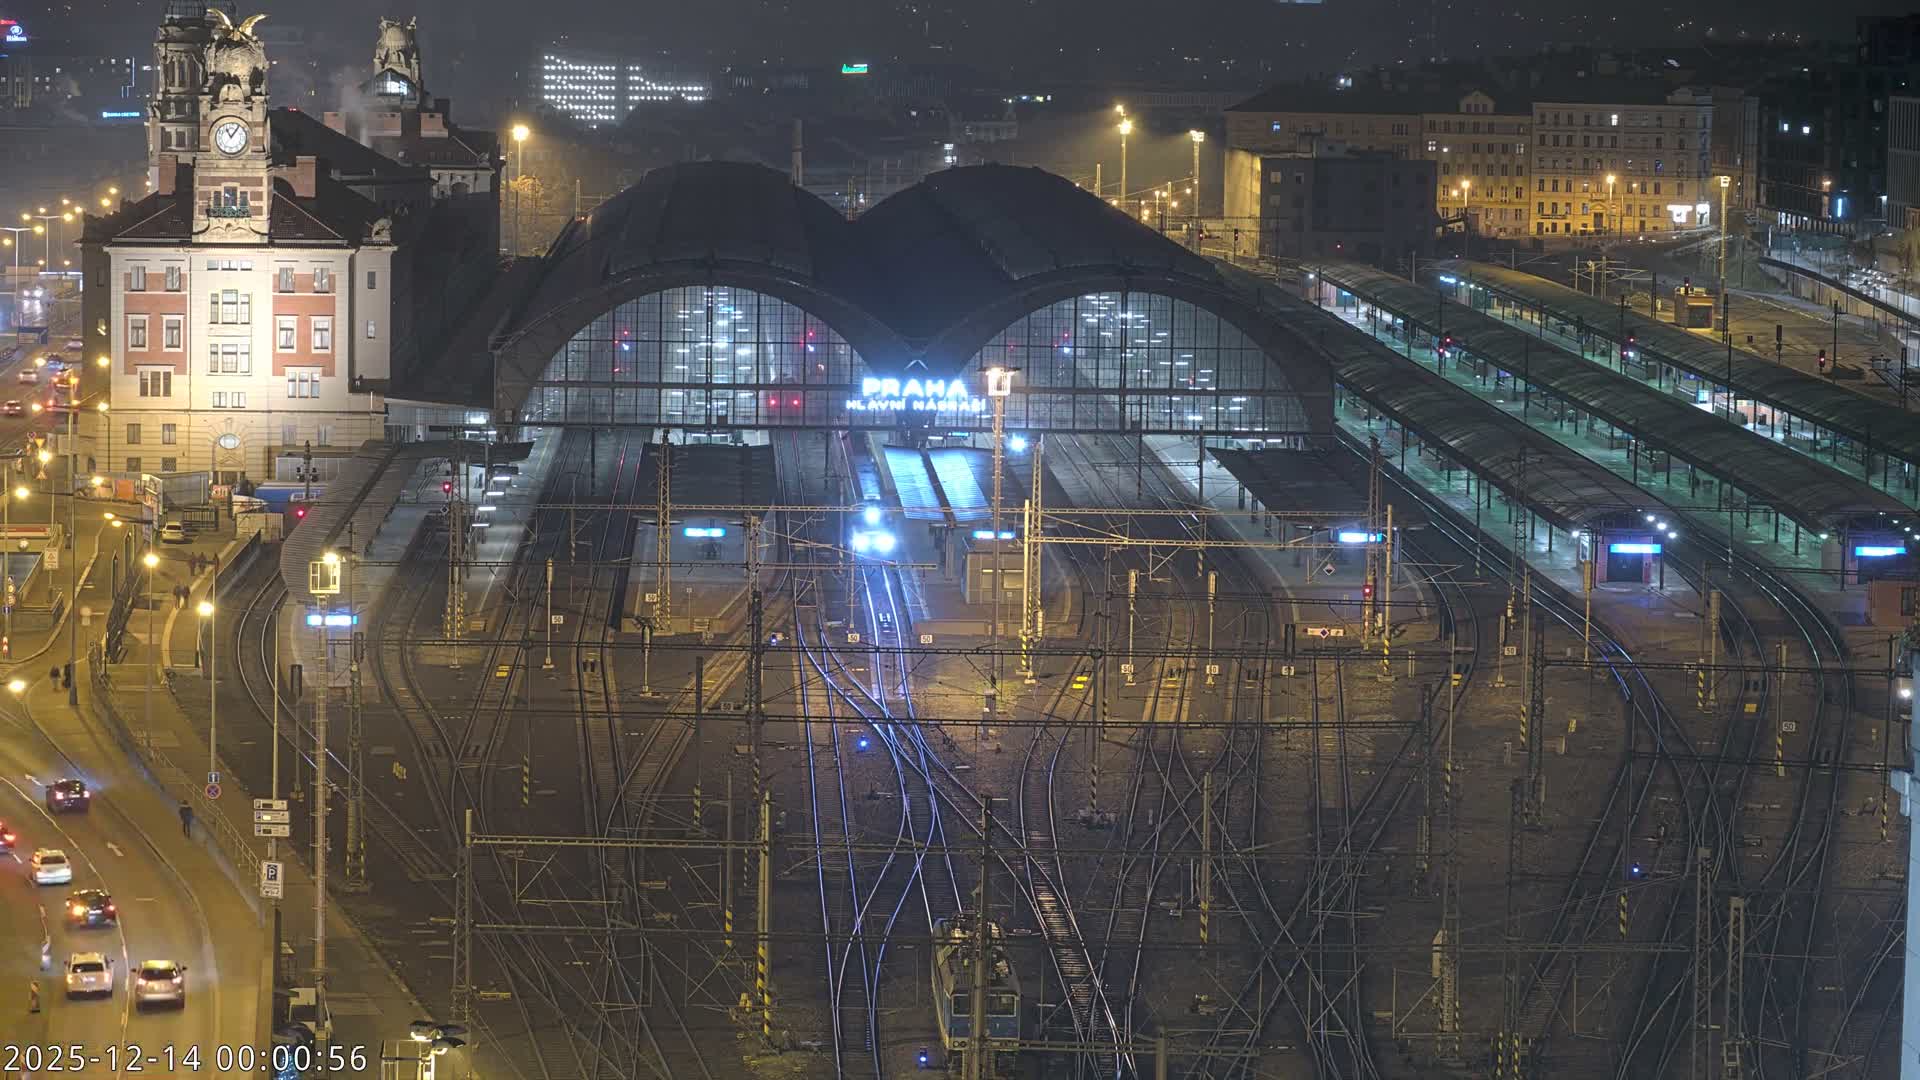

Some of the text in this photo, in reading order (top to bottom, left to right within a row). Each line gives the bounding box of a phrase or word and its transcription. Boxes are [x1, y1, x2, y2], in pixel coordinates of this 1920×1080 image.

[863, 378, 968, 397] PRAHA
[846, 398, 905, 410] HLAVNÍ
[849, 634, 858, 642] 50
[1506, 647, 1515, 655] 50
